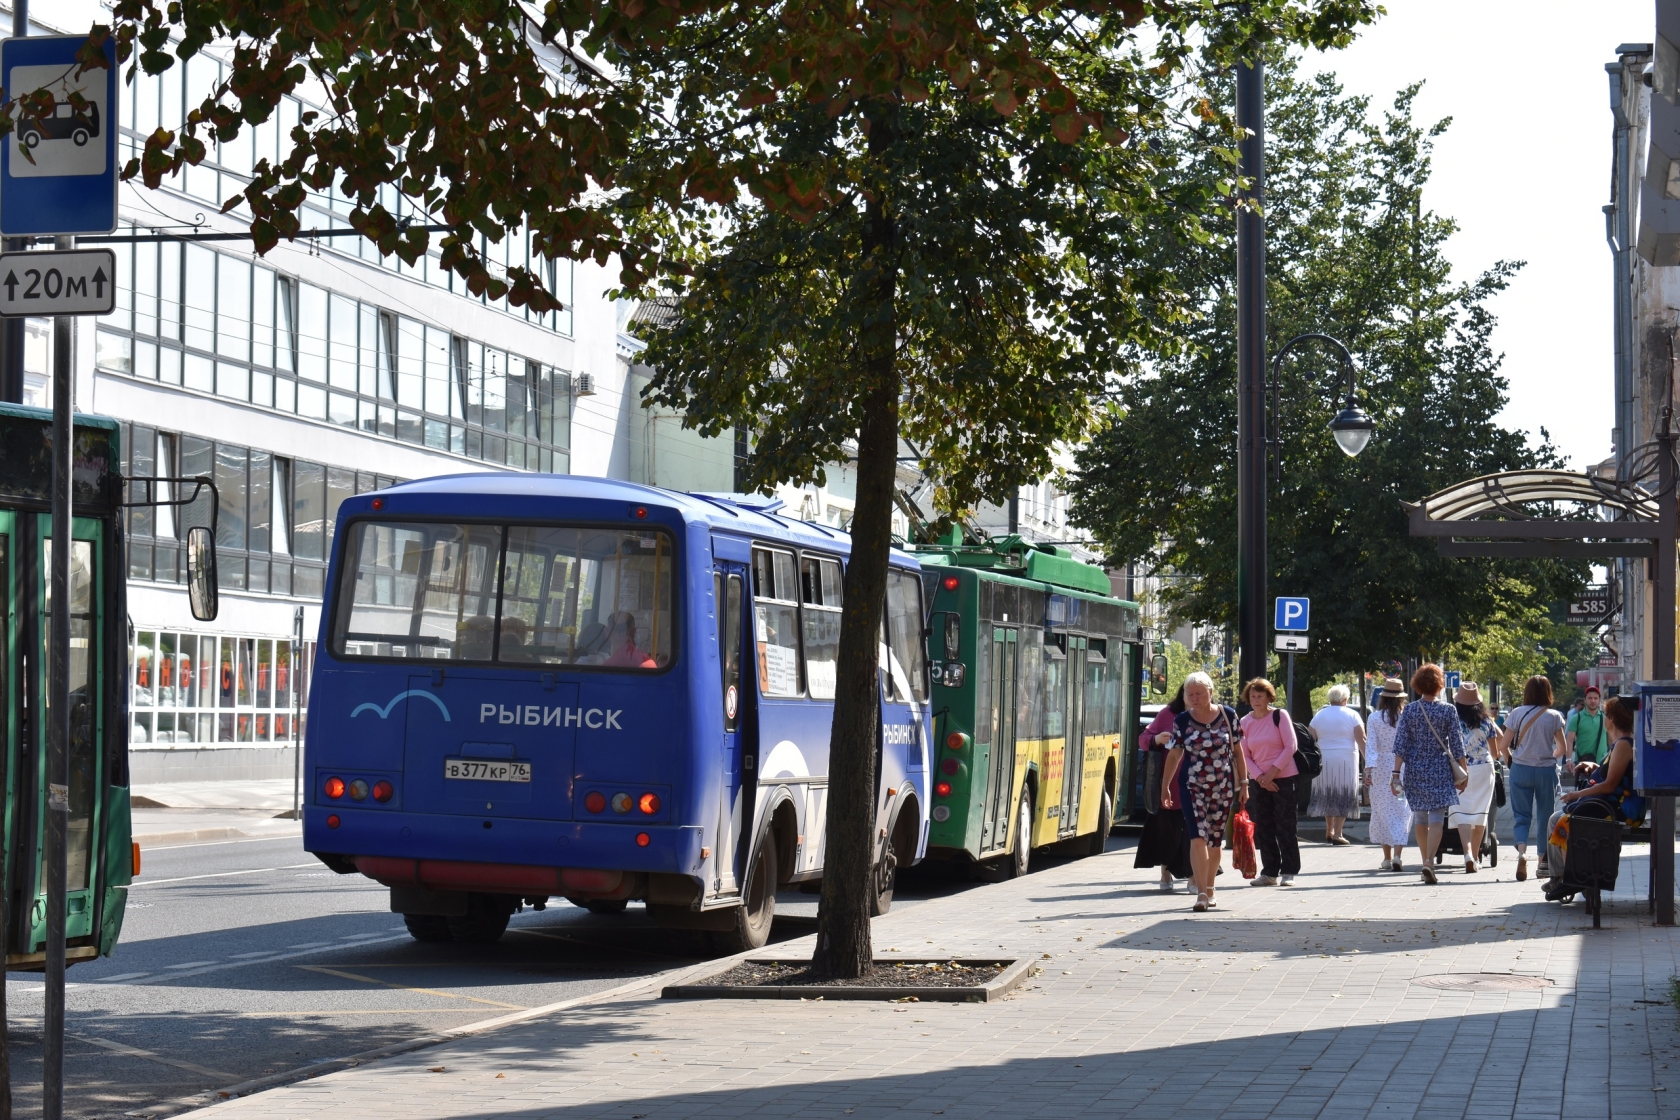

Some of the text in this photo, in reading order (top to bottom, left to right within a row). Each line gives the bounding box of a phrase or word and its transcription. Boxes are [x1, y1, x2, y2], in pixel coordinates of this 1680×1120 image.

[1284, 601, 1303, 627] P
[480, 703, 623, 730] РЫБИНСК
[883, 723, 917, 745] РЫБИНСК
[512, 764, 526, 776] 76
